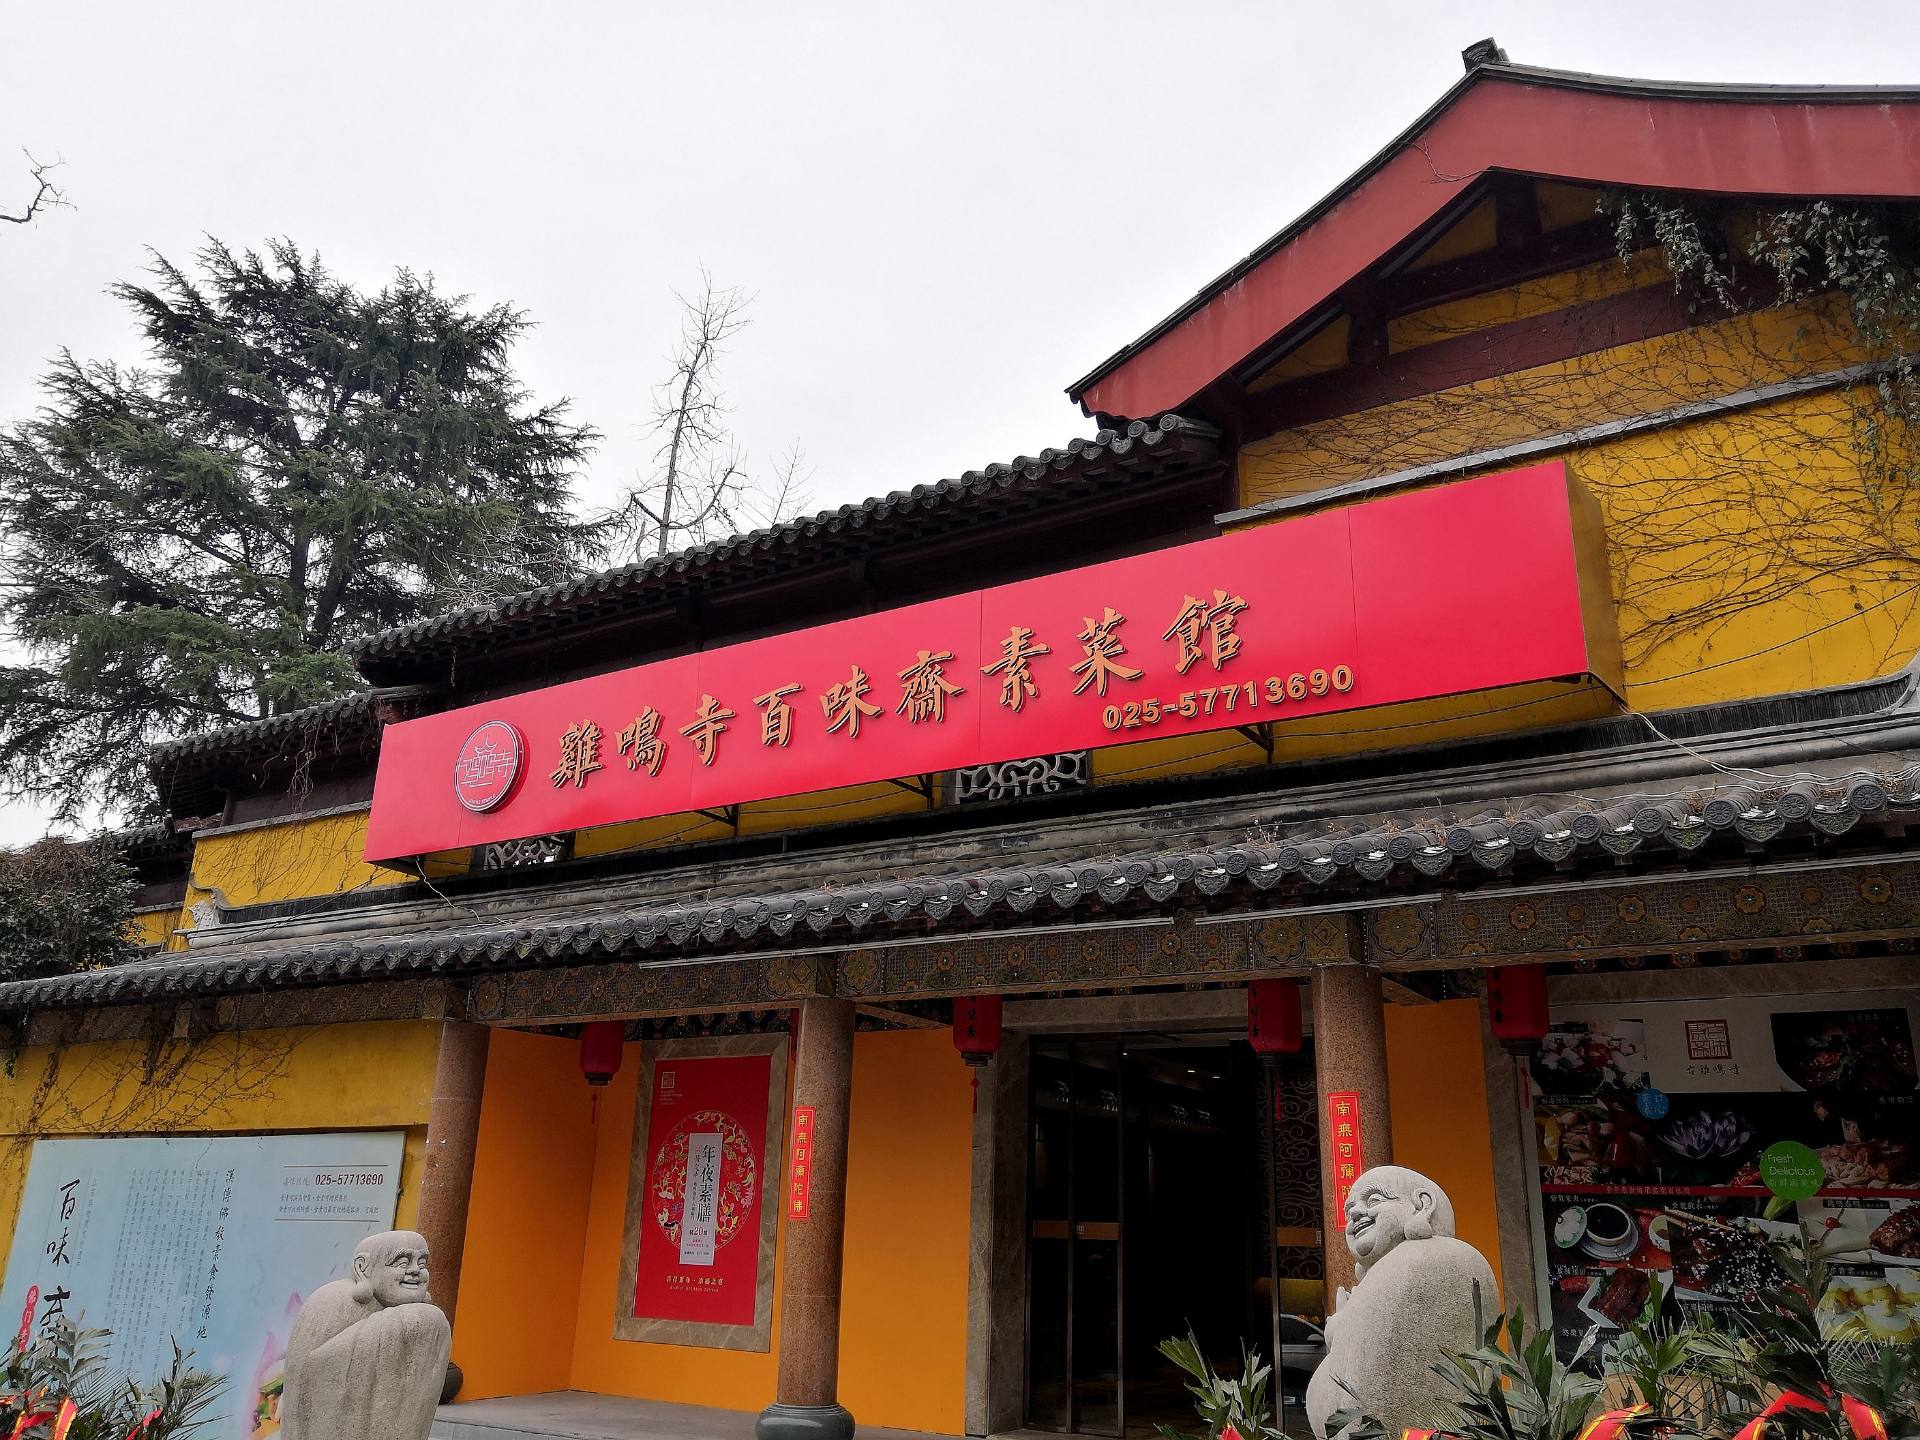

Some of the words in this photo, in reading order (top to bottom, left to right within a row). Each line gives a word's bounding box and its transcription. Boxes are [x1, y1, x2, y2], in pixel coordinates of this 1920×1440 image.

[1101, 663, 1357, 732] 025-57713690
[315, 1173, 384, 1186] 025-57713690
[1336, 1101, 1355, 1222] 南無阿彌陀
[1766, 1154, 1794, 1165] Fresh
[1768, 1166, 1816, 1176] Delicious
[697, 1144, 716, 1223] 年夜素膳
